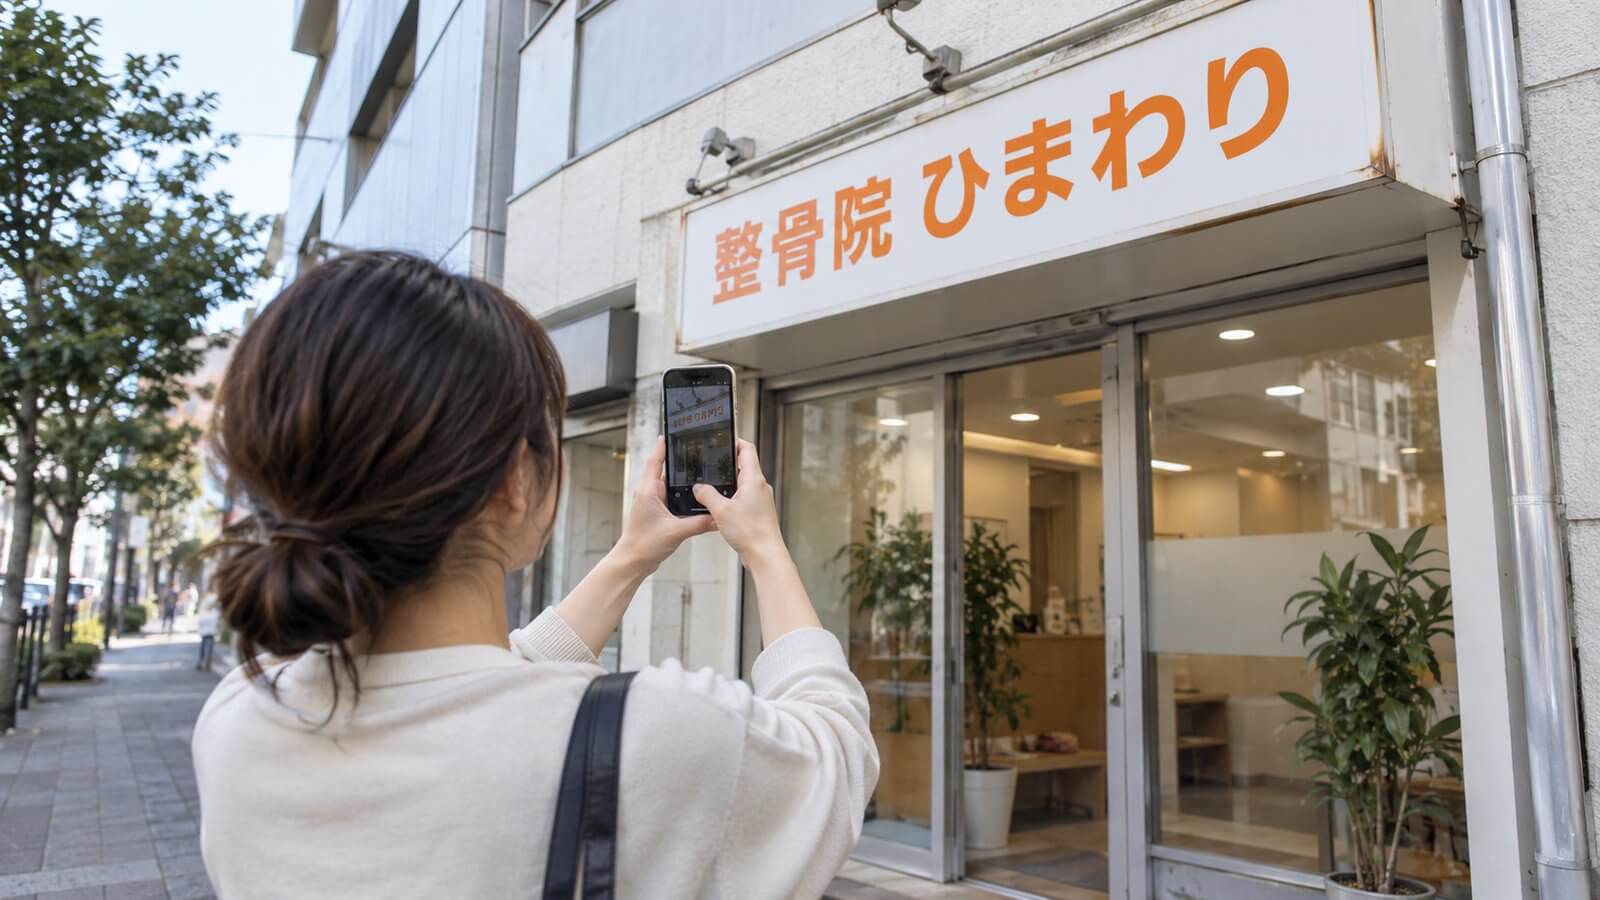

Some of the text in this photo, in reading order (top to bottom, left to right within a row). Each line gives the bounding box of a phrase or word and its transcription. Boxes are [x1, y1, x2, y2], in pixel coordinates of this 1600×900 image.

[712, 47, 1290, 305] 整骨院 ひまわり
